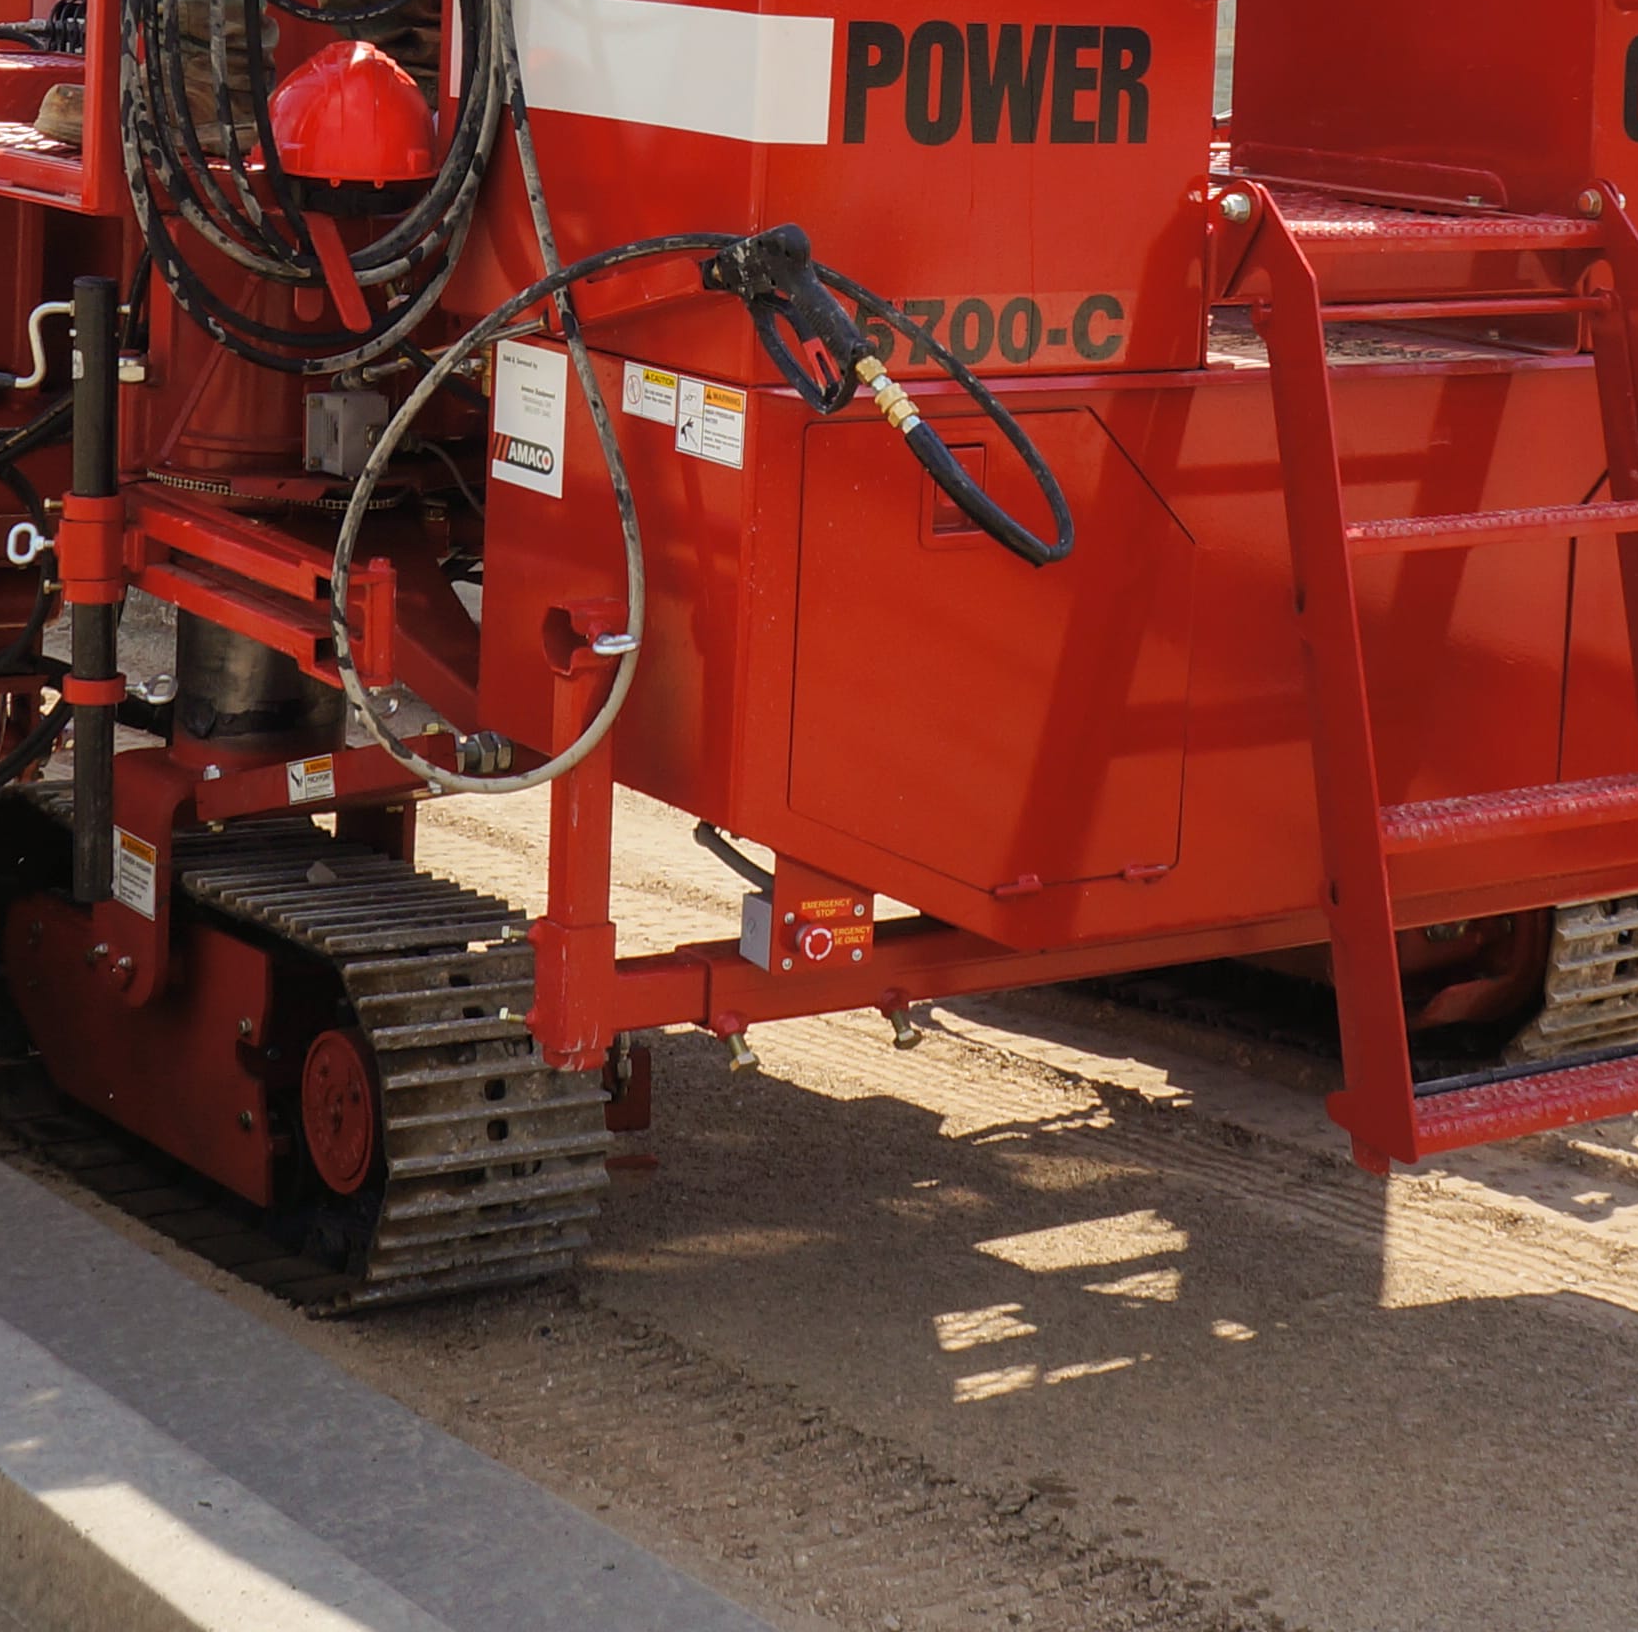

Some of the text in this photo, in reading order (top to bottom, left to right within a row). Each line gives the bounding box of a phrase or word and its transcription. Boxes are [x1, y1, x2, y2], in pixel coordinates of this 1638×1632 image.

[842, 20, 1152, 145] POWER
[856, 294, 1124, 366] 5700-C
[650, 374, 675, 387] CAUTION
[508, 441, 551, 471] AMACO
[802, 899, 852, 910] EMERGENCY
[816, 908, 836, 917] STOP
[832, 926, 871, 936] ERGENCY
[845, 935, 865, 945] ONLY
